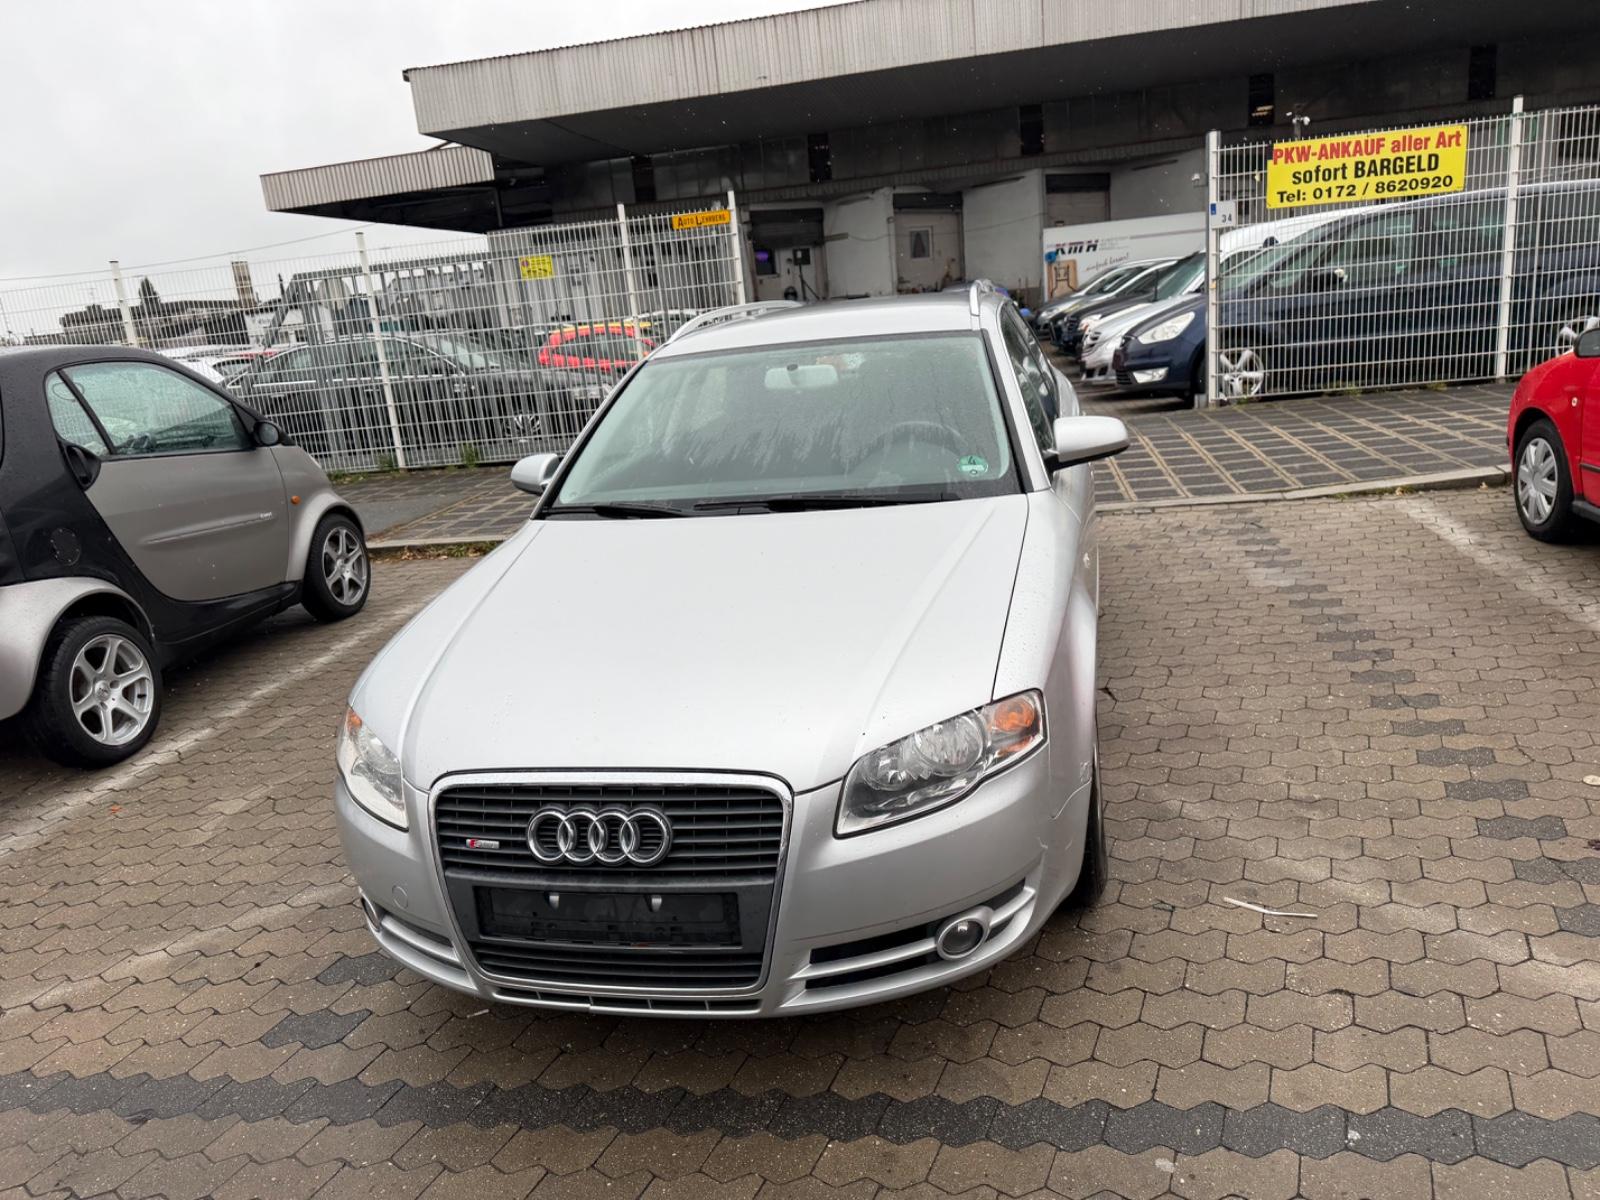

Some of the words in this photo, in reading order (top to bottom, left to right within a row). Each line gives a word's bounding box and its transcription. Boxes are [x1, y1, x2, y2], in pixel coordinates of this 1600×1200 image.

[1272, 137, 1386, 165] PKW-ANKAUF
[1391, 134, 1431, 154] aller
[1436, 130, 1462, 149] Art
[1292, 163, 1348, 185] sofort
[1354, 153, 1440, 179] BARGELD
[1277, 189, 1306, 203] Tel:
[1313, 184, 1357, 199] 0172
[1362, 182, 1370, 195] /
[1375, 175, 1454, 194] 8620920
[1221, 213, 1232, 223] 34
[967, 455, 977, 465] 4
